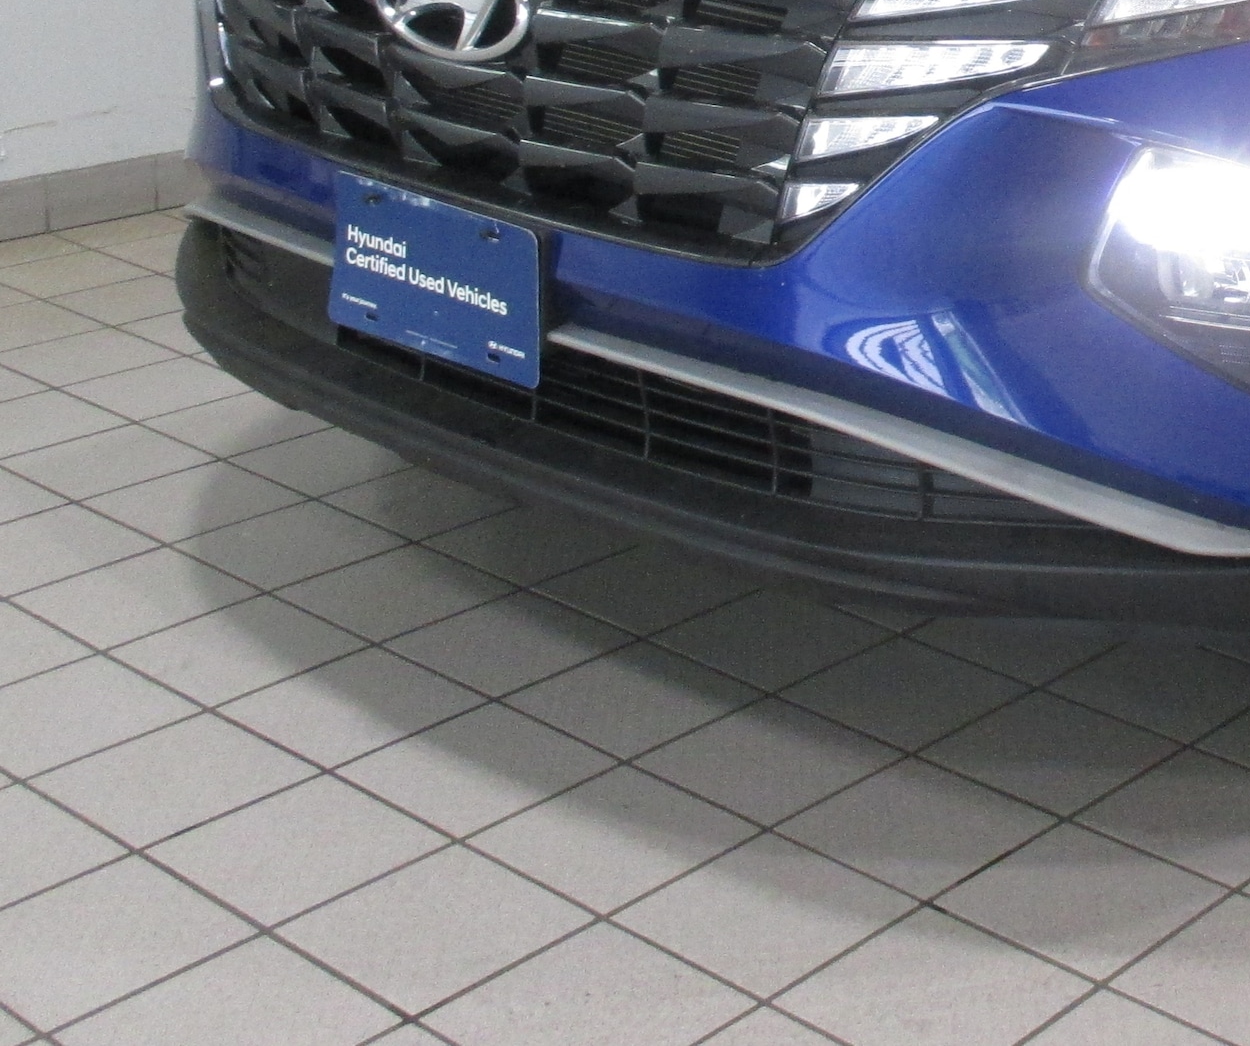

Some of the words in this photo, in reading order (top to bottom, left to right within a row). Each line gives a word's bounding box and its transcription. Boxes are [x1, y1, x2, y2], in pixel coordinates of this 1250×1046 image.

[347, 224, 407, 258] Hyundai
[345, 247, 406, 281] Certified
[409, 266, 445, 294] Used
[447, 279, 508, 316] Vehicles
